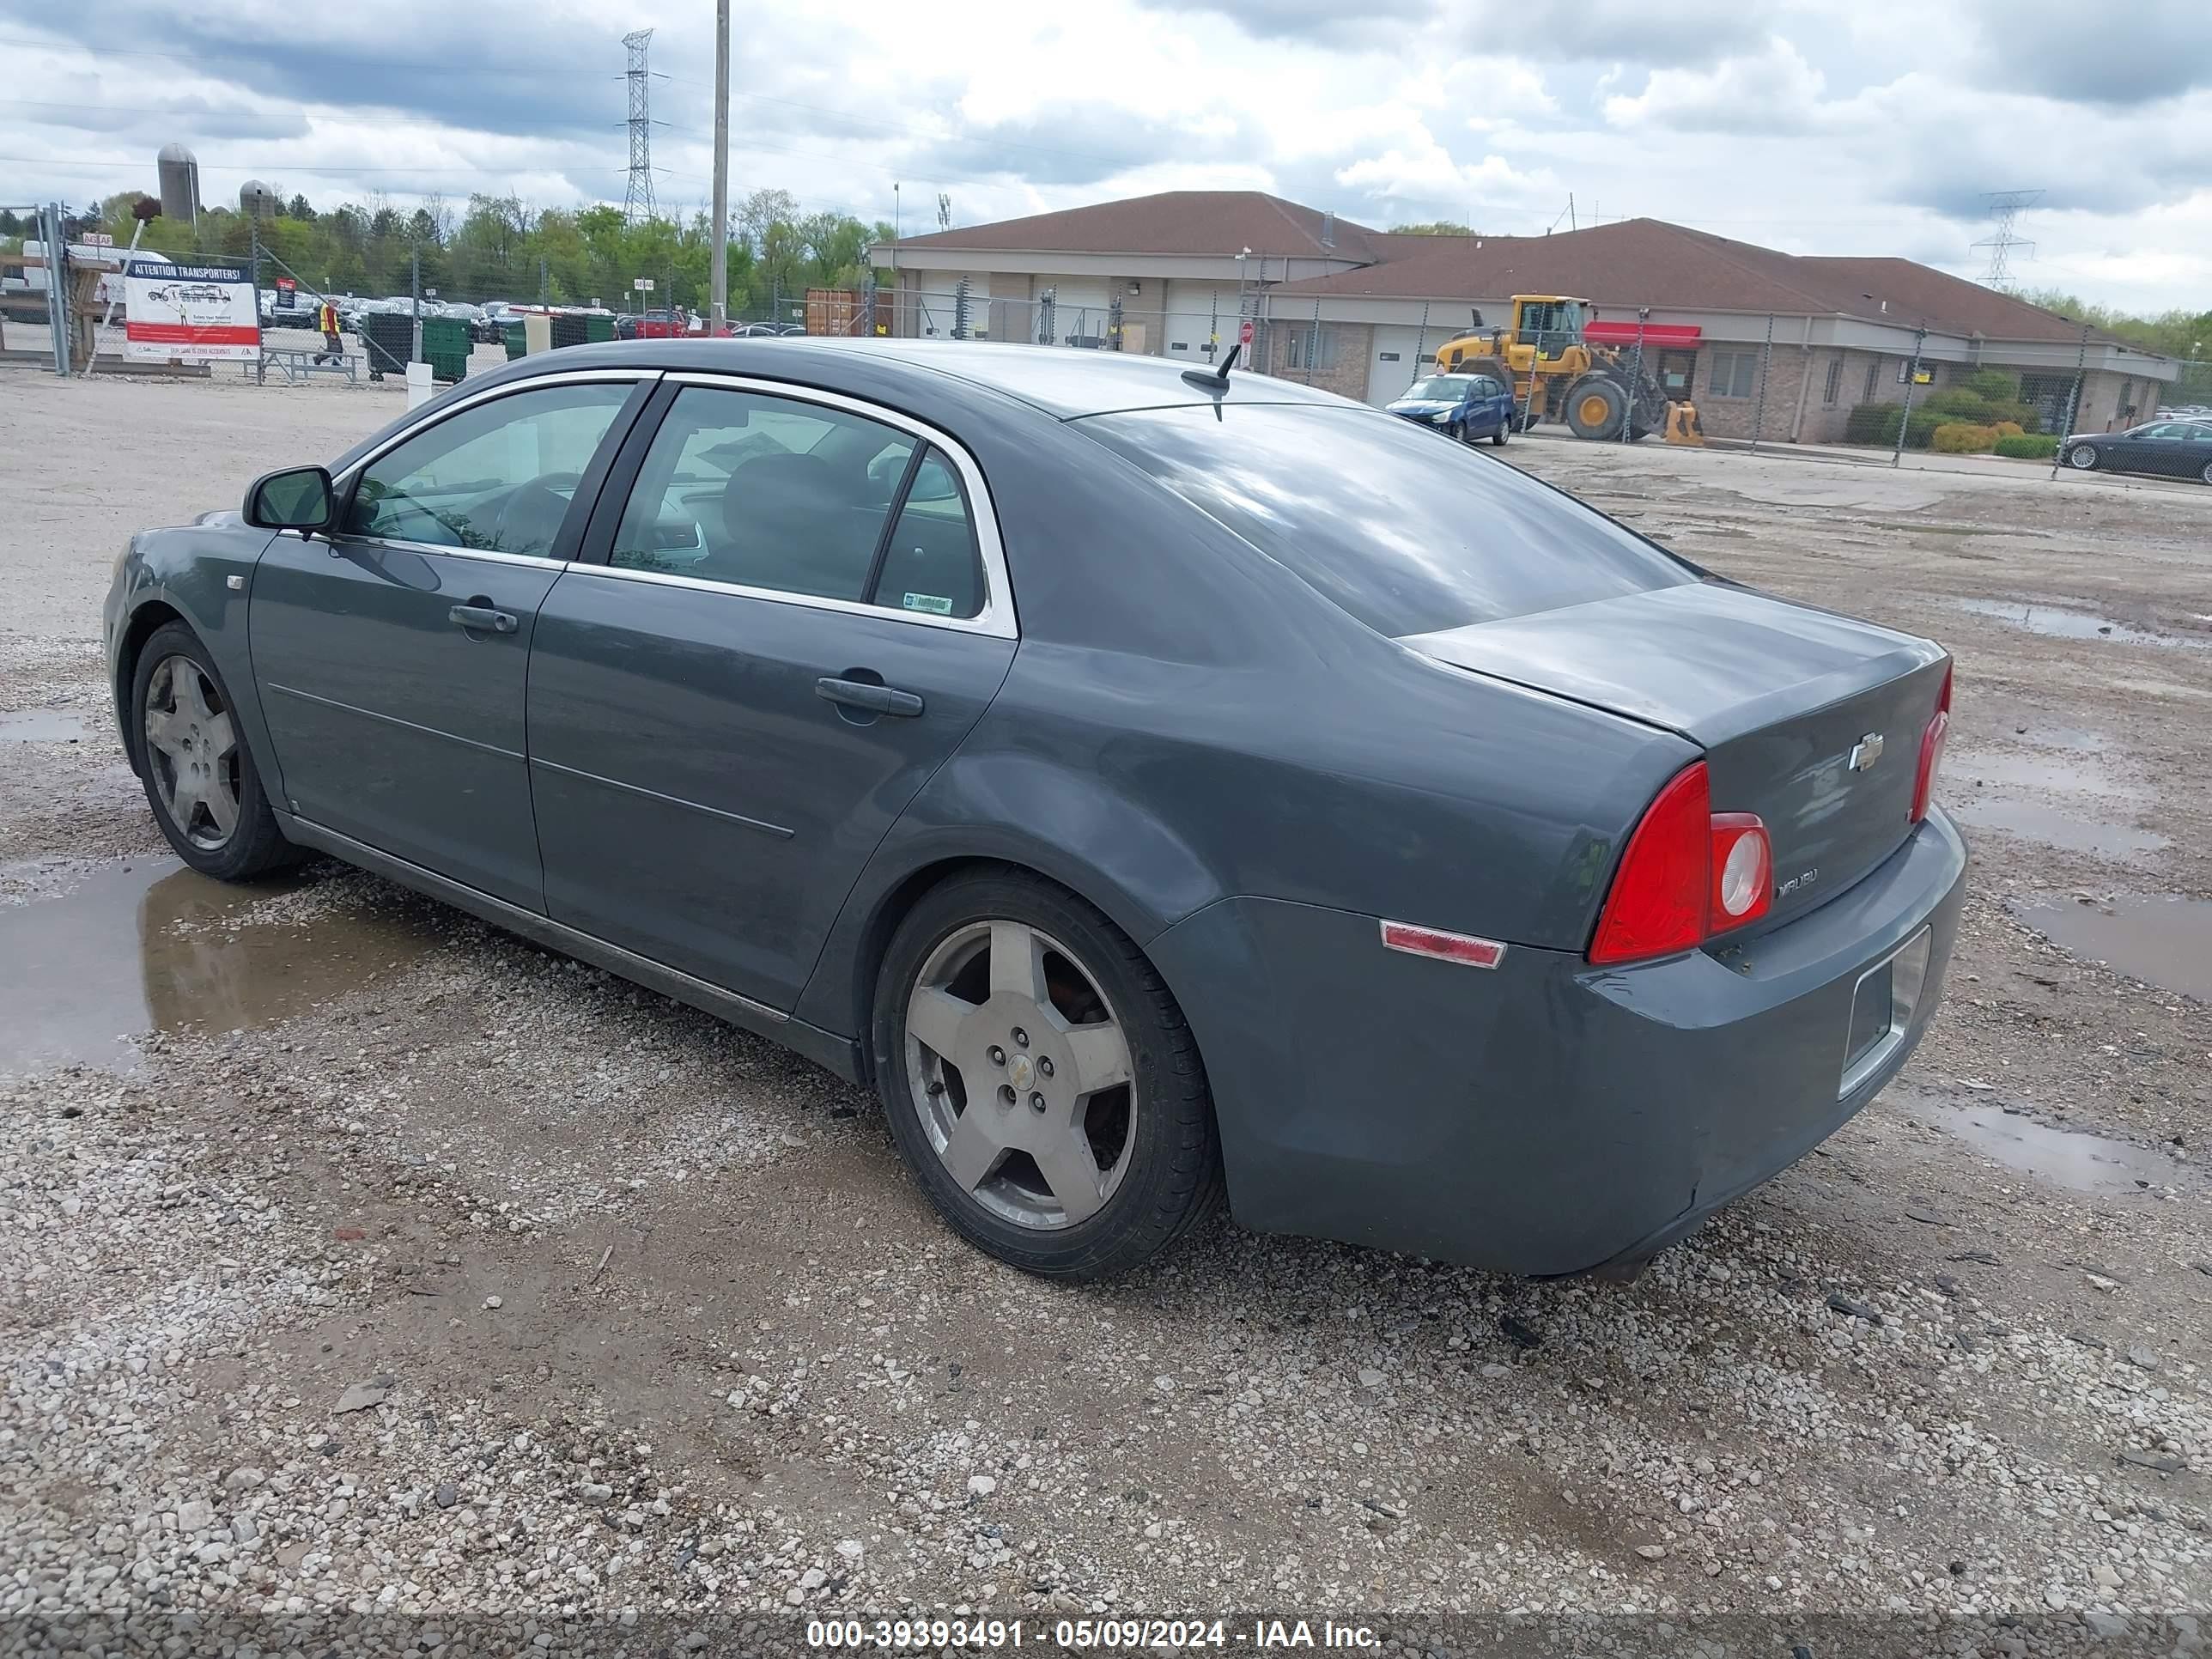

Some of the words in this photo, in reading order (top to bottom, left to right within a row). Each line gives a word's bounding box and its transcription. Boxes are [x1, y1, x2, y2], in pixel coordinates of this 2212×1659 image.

[135, 264, 177, 276] ATTENTION
[178, 266, 240, 280] TRANSPORTERS!
[1778, 868, 1818, 899] MALIBU
